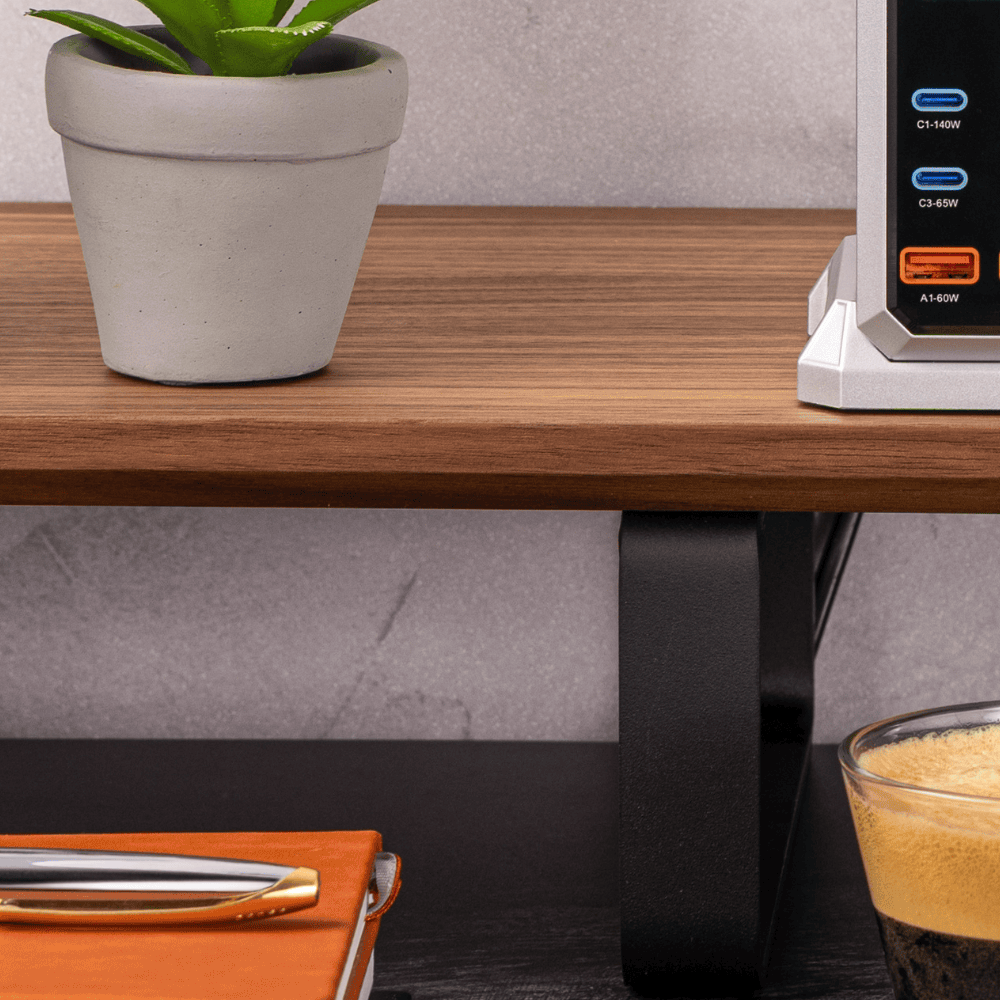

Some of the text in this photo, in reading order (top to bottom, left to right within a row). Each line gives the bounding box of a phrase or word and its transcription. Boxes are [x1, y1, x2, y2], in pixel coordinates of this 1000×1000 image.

[916, 119, 961, 130] C1-140W
[918, 198, 959, 208] C3-65W
[919, 293, 960, 303] A1-60W
